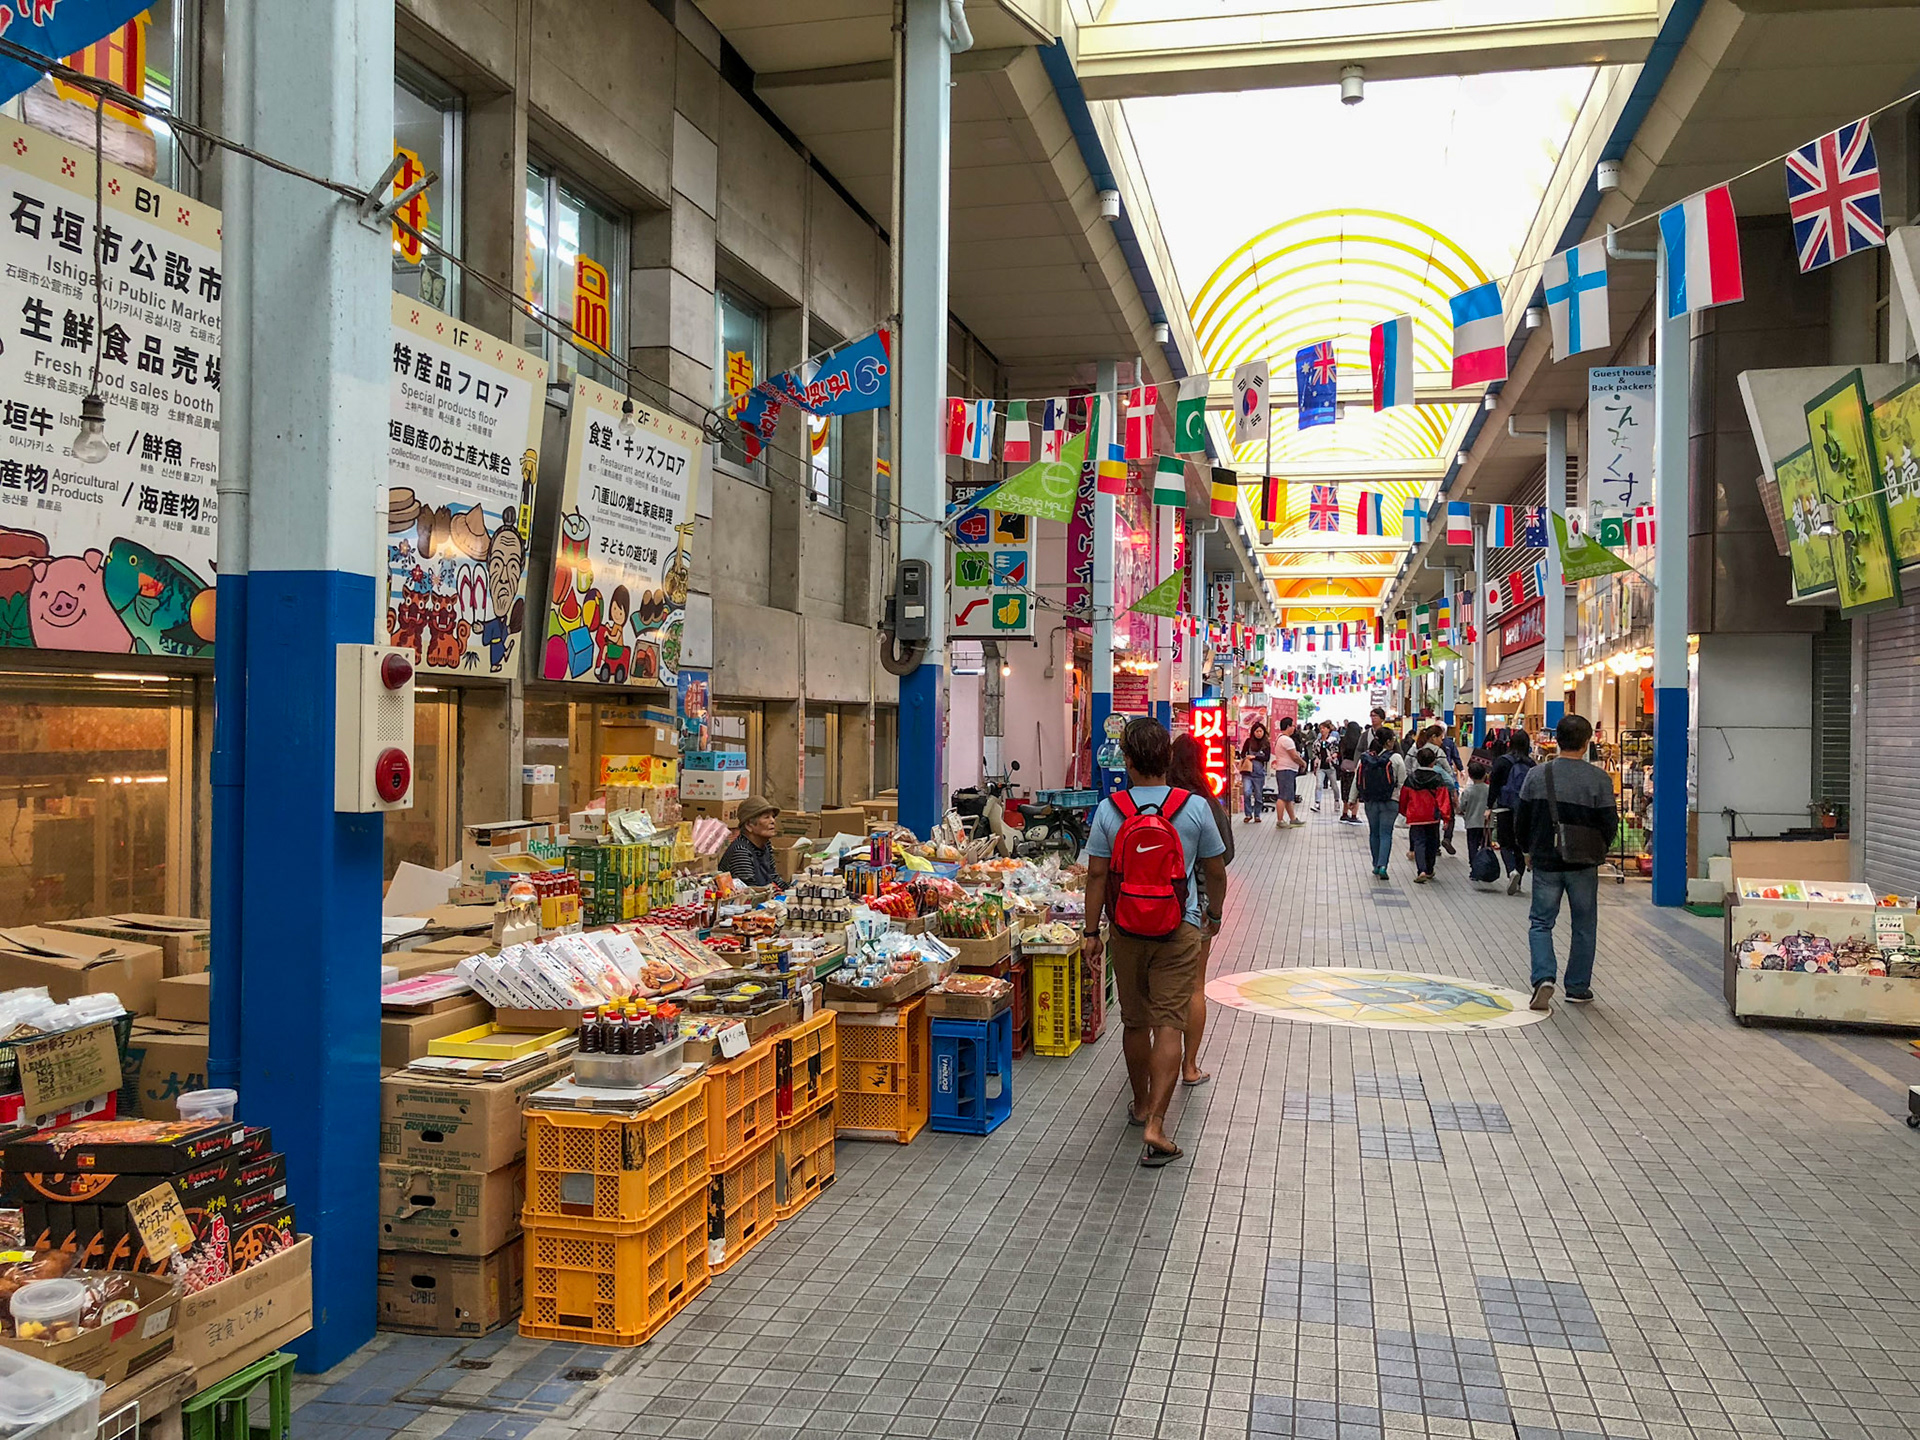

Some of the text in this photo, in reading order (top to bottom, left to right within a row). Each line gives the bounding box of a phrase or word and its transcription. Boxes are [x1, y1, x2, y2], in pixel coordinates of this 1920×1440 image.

[135, 187, 160, 217] B1
[47, 255, 113, 292] Ishigaki
[119, 281, 166, 310] Public
[145, 311, 181, 333] 공설시장
[453, 328, 469, 348] 1F
[34, 351, 214, 413] Fresh food sales booth
[393, 342, 509, 408] 特産品フロア
[1623, 369, 1651, 377] house
[1592, 383, 1653, 393] Back packers
[0, 399, 54, 436] 垣牛
[141, 401, 160, 417] 매장
[401, 383, 498, 427] Special products floor
[638, 410, 650, 425] 2F
[141, 432, 182, 467] 鮮魚
[588, 421, 685, 476] 食堂・キッズフロア
[190, 457, 217, 473] Fresh
[391, 447, 421, 462] collection
[422, 454, 428, 463] of
[428, 456, 455, 474] souvenirs
[456, 463, 482, 480] produced
[482, 473, 489, 482] on
[600, 455, 673, 489] Restaurant and Kids floor
[52, 468, 119, 492] Agricultural
[50, 484, 104, 504] Products
[138, 484, 199, 521] 海産物
[591, 485, 673, 525] 八重山の郷土家庭料理
[1043, 499, 1070, 514] MALL
[597, 505, 609, 515] Local
[610, 509, 622, 520] home
[622, 513, 640, 526] cooking
[600, 536, 658, 566] 子どもの遊び場
[404, 1121, 458, 1133] BANANAS
[443, 1163, 471, 1171] PRODUCT
